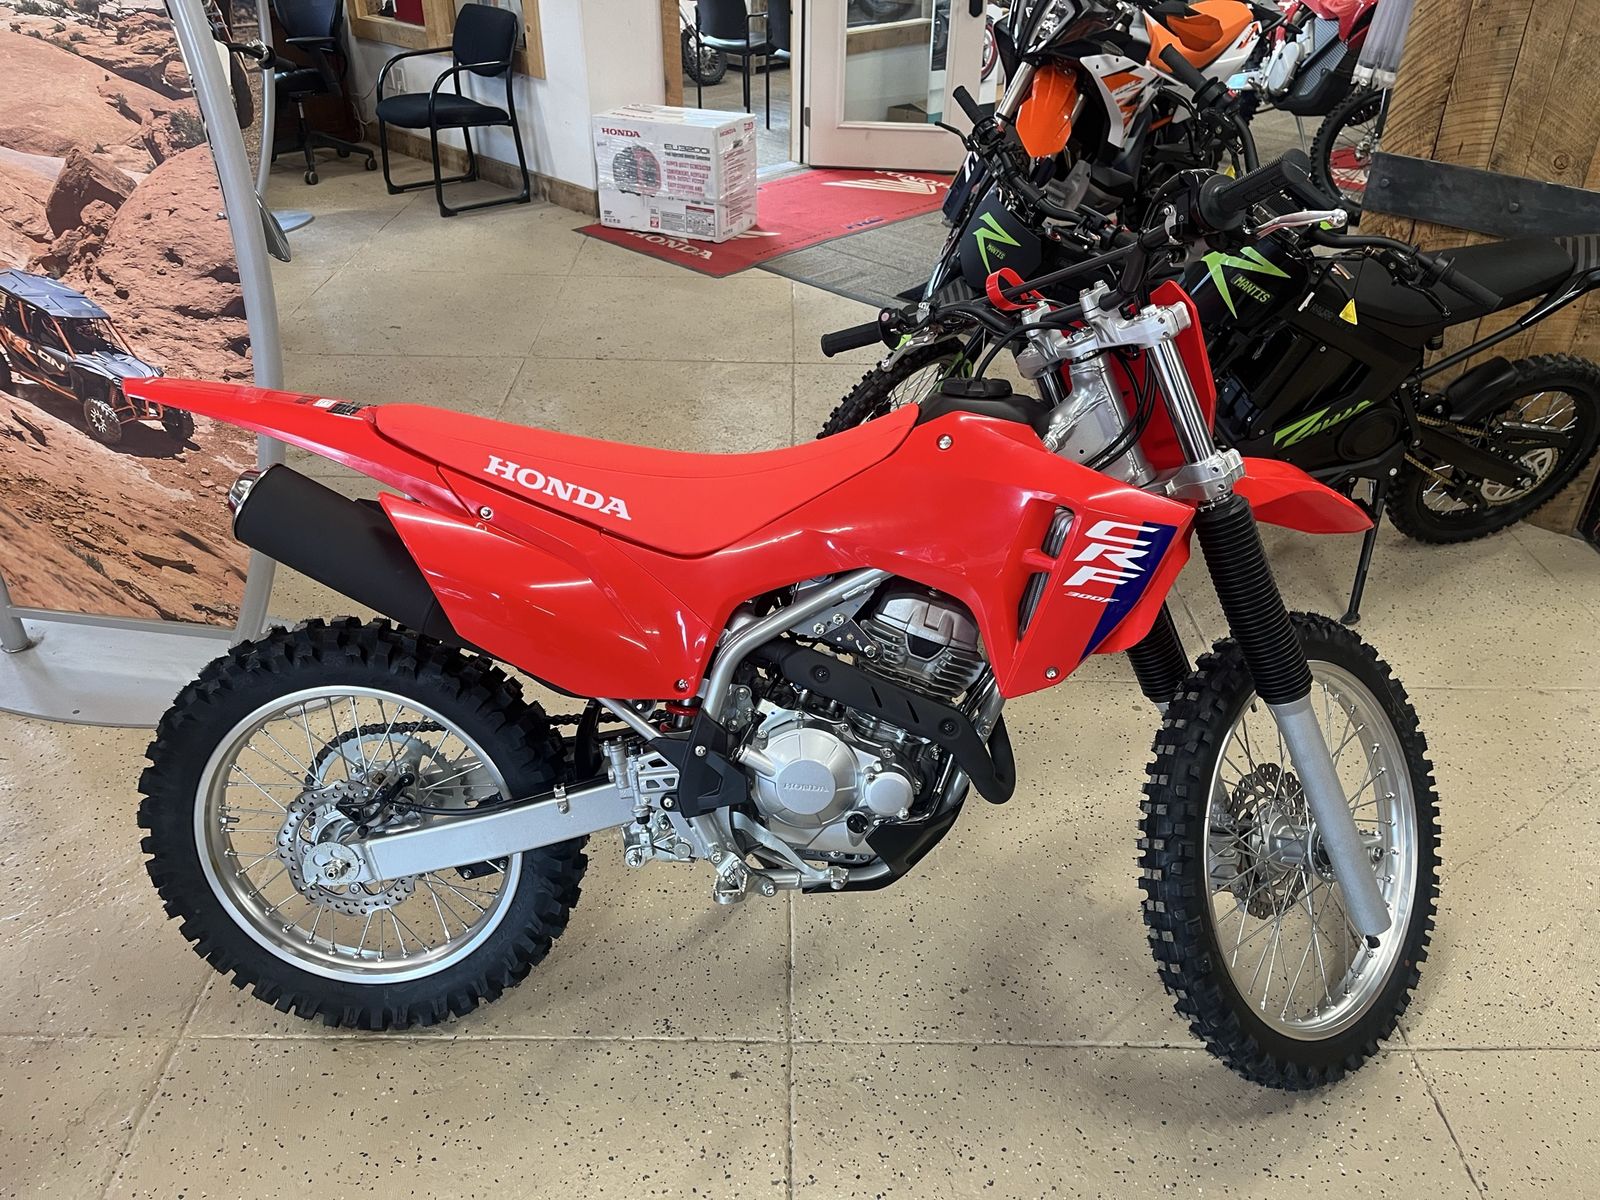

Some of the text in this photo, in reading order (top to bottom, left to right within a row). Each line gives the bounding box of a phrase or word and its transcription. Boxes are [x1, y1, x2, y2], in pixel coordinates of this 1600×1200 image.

[601, 127, 641, 138] HONDA
[1233, 275, 1271, 303] MANTIS
[483, 454, 632, 521] HONDA
[1062, 520, 1160, 586] CRF
[1064, 591, 1120, 603] 300F
[783, 783, 830, 793] HONDA
